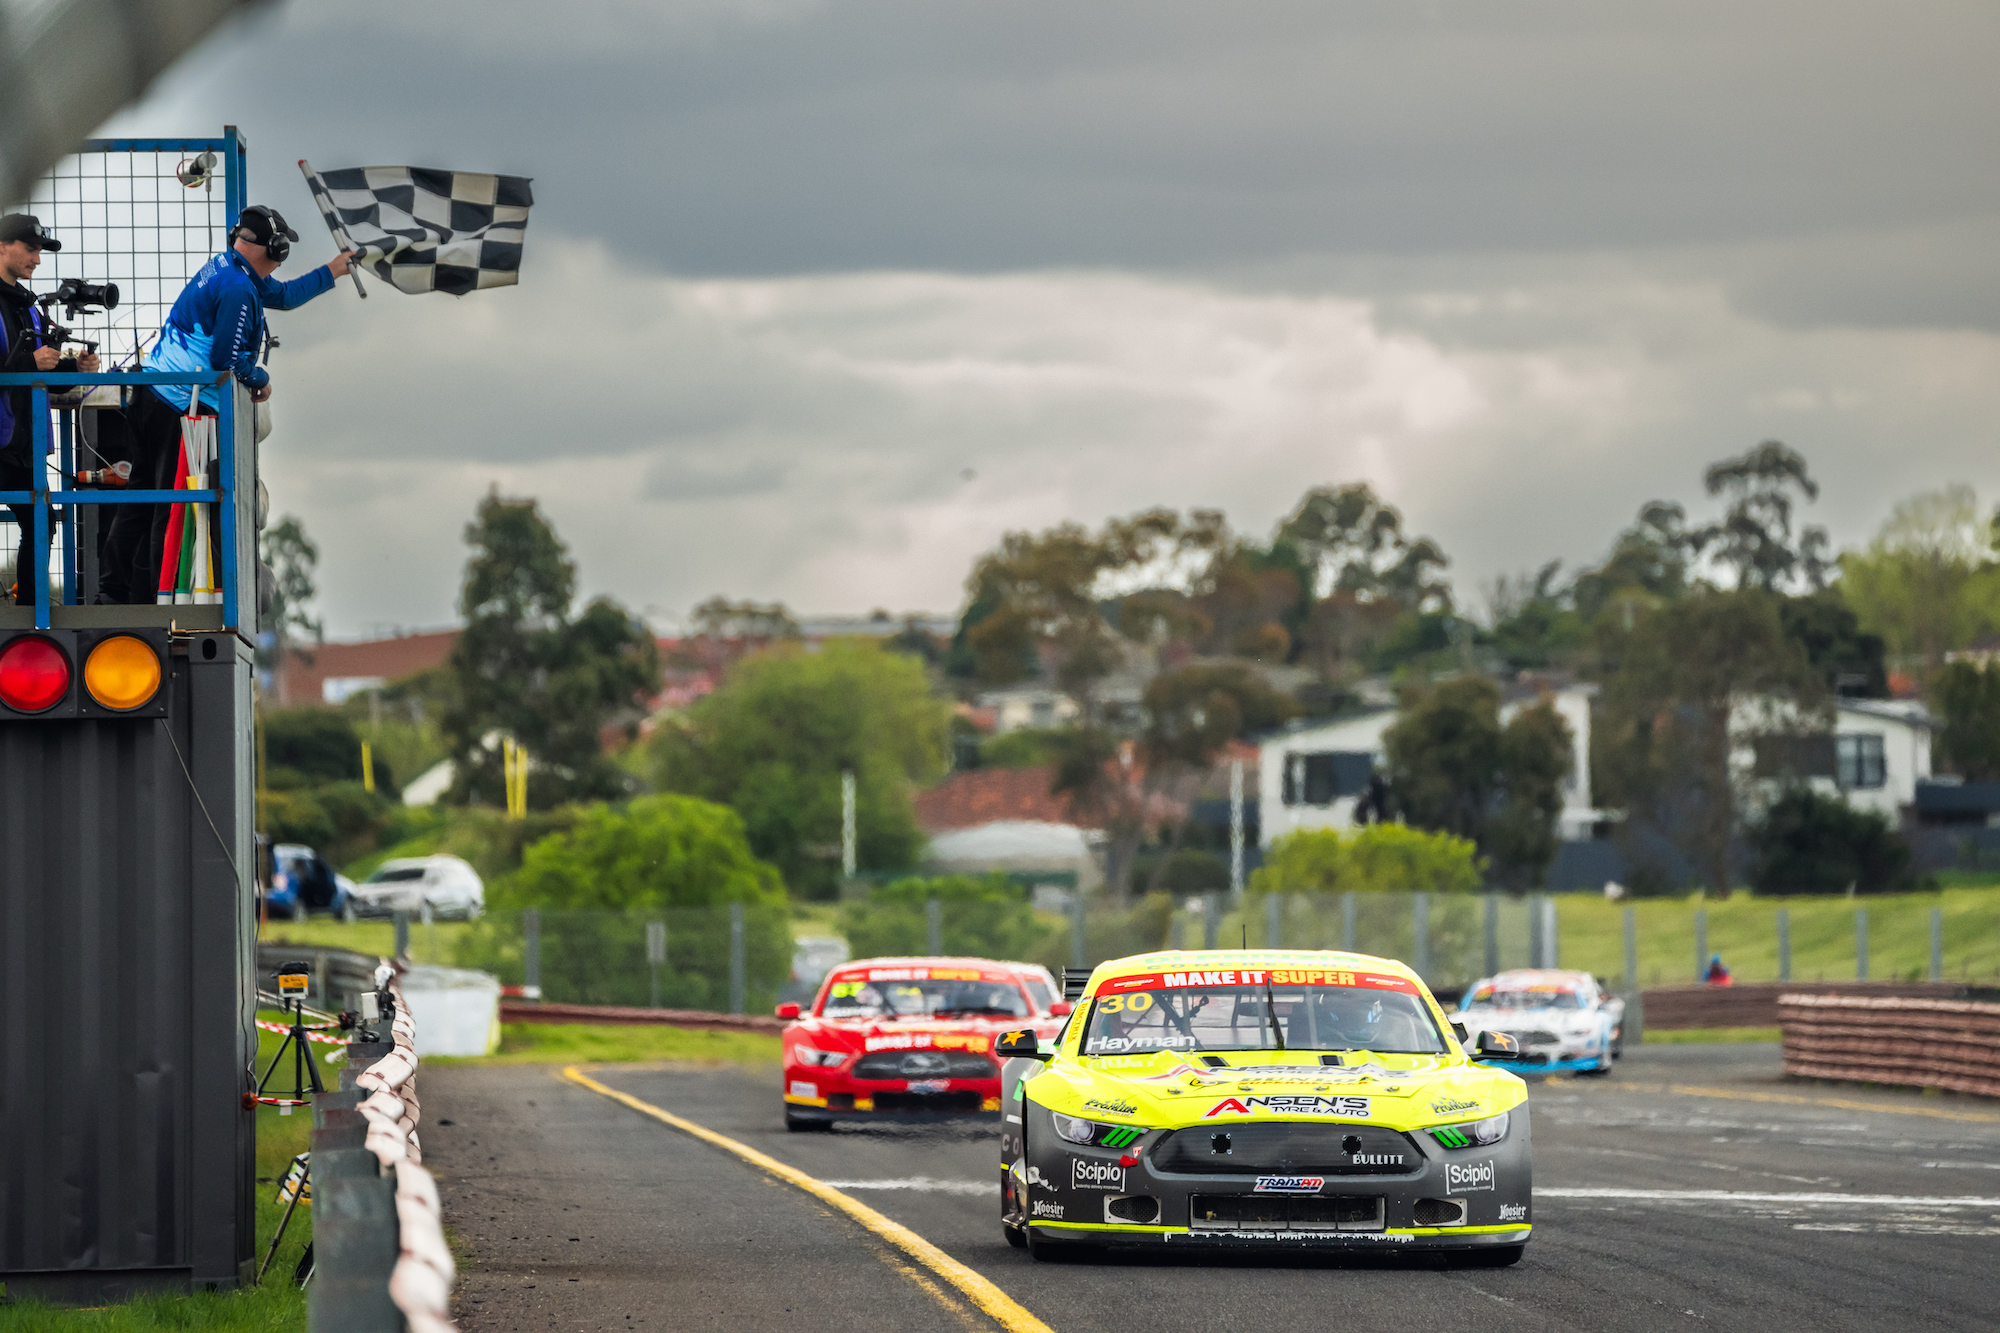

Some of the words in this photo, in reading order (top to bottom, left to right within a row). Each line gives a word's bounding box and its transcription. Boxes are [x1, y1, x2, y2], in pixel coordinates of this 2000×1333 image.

[1163, 971, 1236, 987] MAKE
[1241, 971, 1266, 984] IT
[1272, 970, 1356, 986] SUPER
[1099, 992, 1153, 1014] 30
[1086, 1035, 1196, 1052] Hayman
[1206, 1095, 1367, 1117] ANSEN'S
[1325, 1107, 1369, 1117] AUTO
[1353, 1154, 1404, 1165] BULLITT
[1075, 1161, 1121, 1185] Scipio
[1450, 1163, 1491, 1187] Scipio
[1031, 1200, 1065, 1215] Hoosier
[1498, 1203, 1527, 1219] Hoosier
